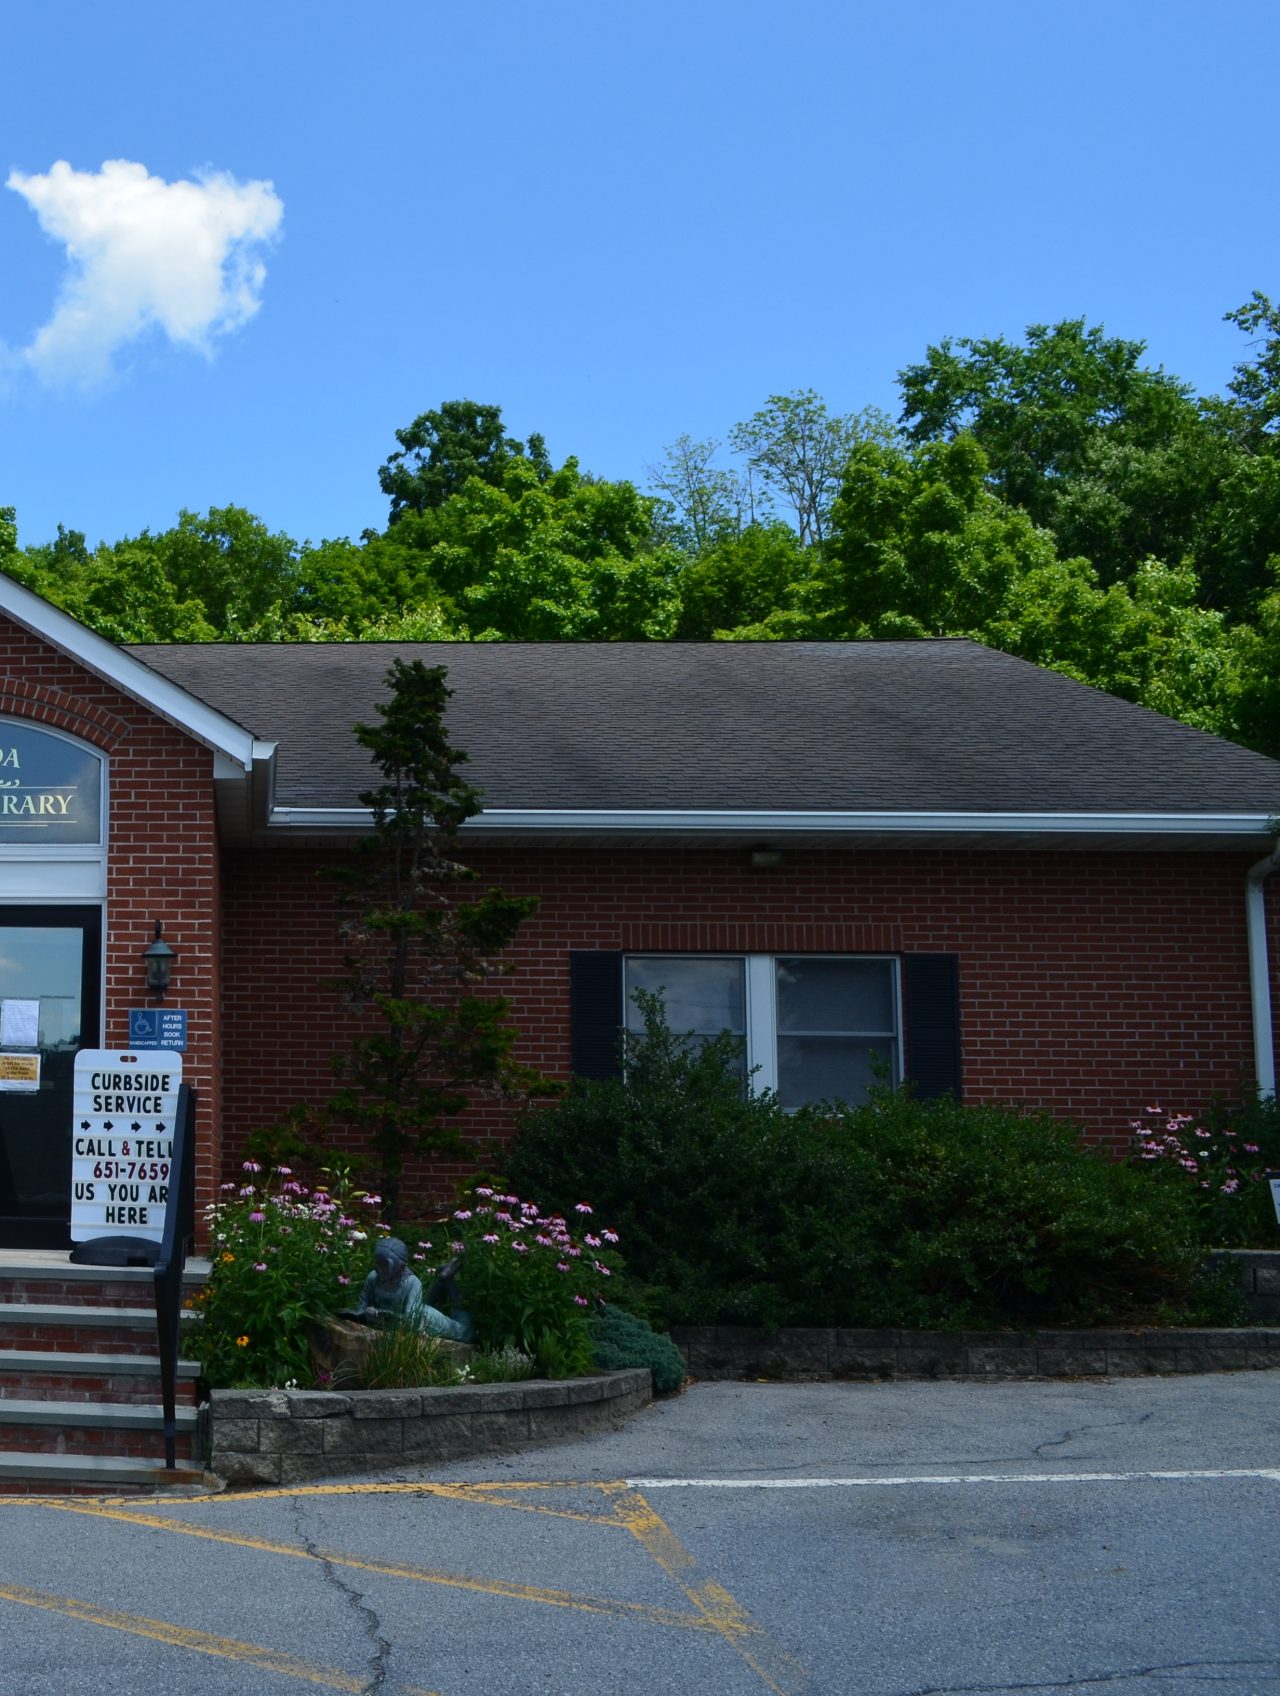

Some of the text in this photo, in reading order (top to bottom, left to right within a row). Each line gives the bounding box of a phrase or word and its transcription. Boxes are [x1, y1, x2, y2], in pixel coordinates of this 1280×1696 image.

[91, 1073, 170, 1092] CURBSIDE
[93, 1095, 162, 1113] SERVICE
[75, 1138, 117, 1157] CALL
[121, 1141, 130, 1156] &
[93, 1161, 170, 1181] 651-7659
[75, 1183, 95, 1200] US
[108, 1183, 140, 1201] YOU
[106, 1207, 148, 1225] HERE
